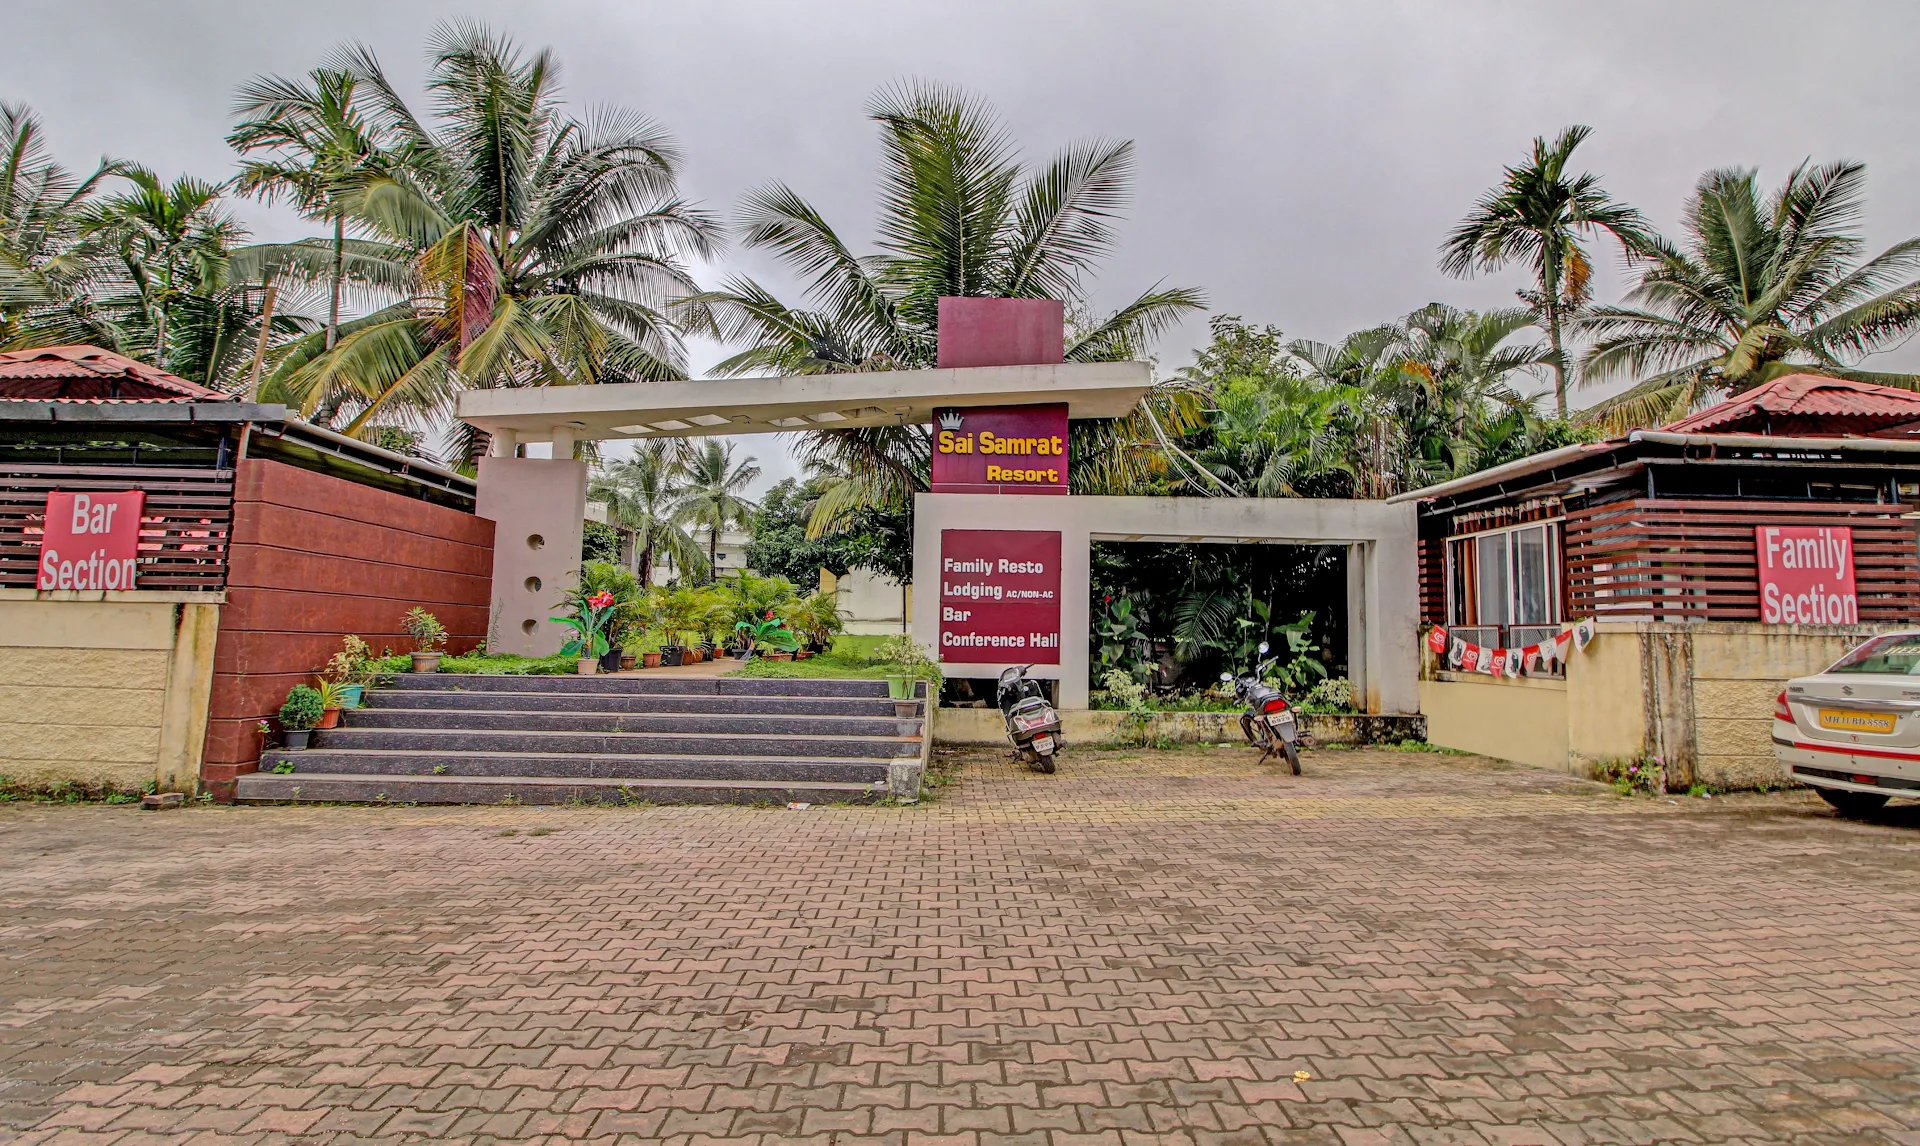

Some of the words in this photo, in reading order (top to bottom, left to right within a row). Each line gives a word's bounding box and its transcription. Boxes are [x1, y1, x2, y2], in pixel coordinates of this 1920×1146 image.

[939, 430, 973, 454] Sai
[979, 431, 1063, 456] Samrat
[987, 465, 1059, 483] Resort
[71, 494, 118, 535] Bar
[1765, 528, 1847, 580] Family
[40, 549, 136, 591] Section
[944, 558, 993, 576] Family
[998, 558, 1043, 574] Resto
[943, 581, 1003, 600] Lodging
[1006, 590, 1054, 599] AC/NON-AC
[943, 607, 971, 622] Bar
[1764, 582, 1858, 625] Section
[942, 631, 1025, 647] Conference
[1029, 632, 1058, 648] Hall
